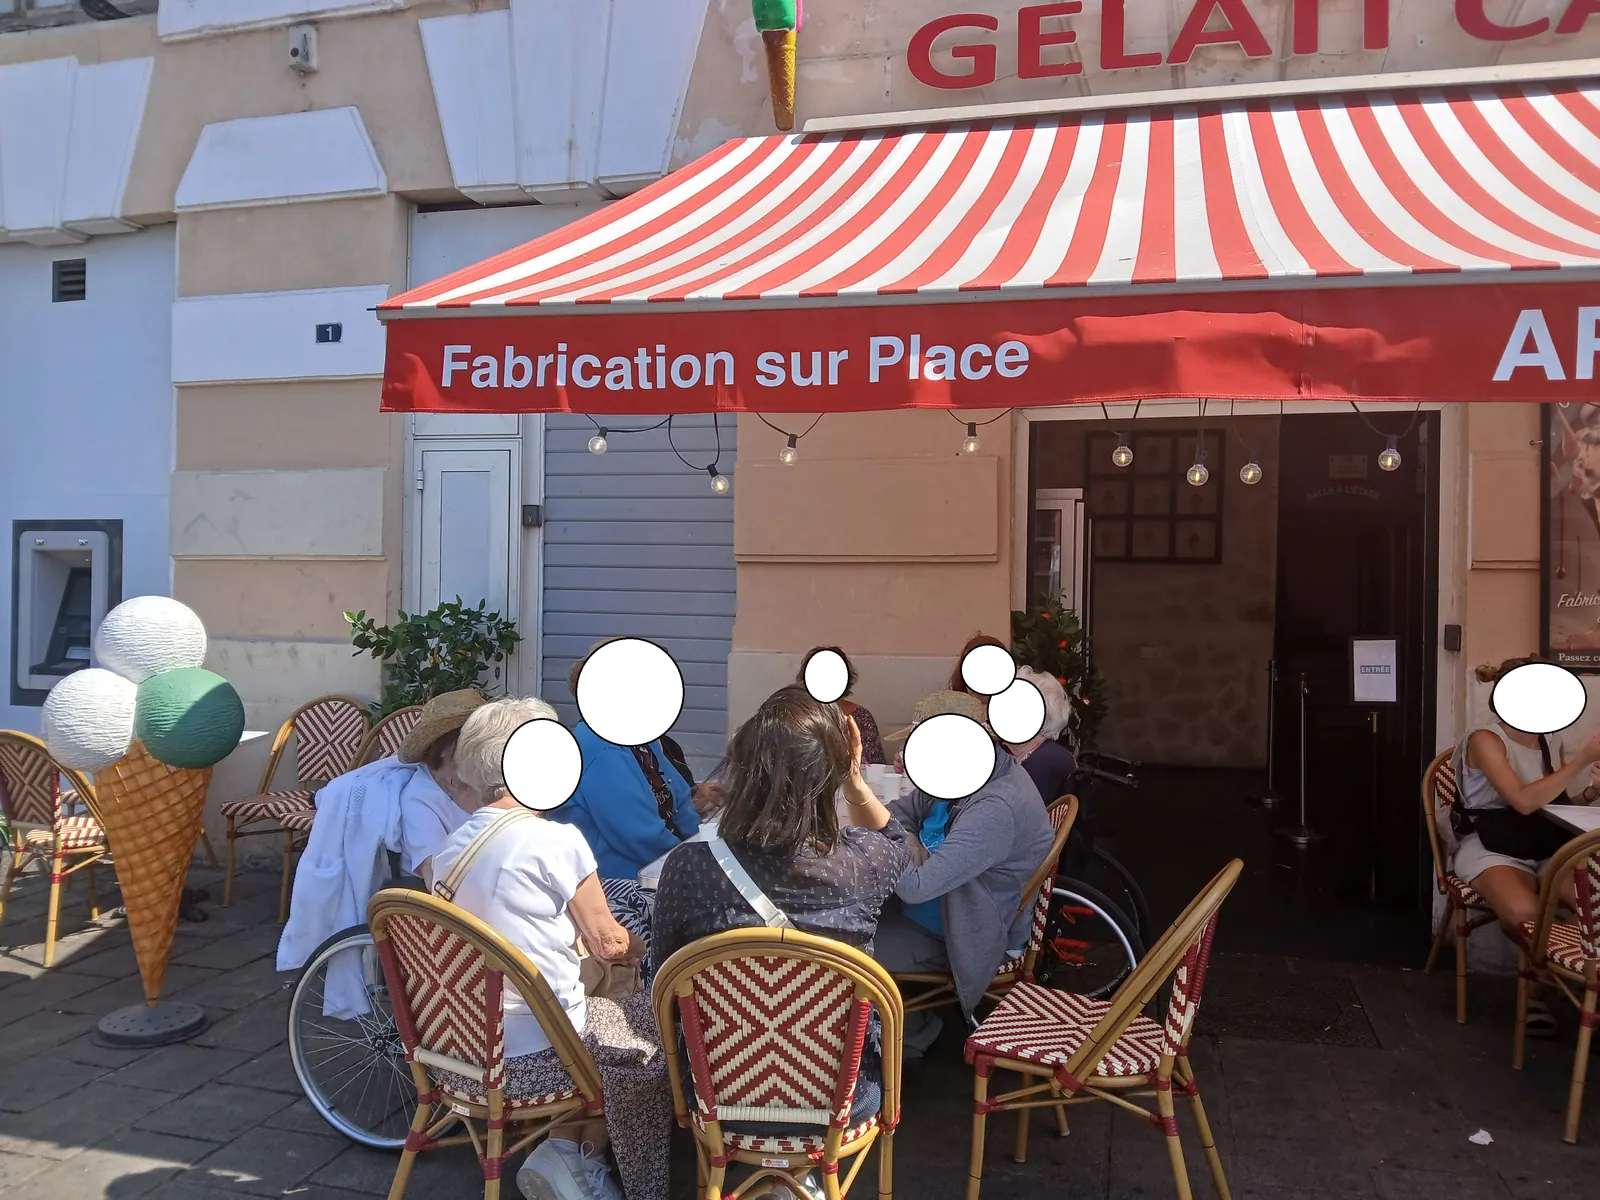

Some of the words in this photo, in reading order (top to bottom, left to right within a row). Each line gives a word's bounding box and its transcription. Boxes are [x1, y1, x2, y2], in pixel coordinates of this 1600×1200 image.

[326, 325, 333, 341] 1
[440, 341, 736, 391] Fabrication
[754, 349, 850, 388] sur
[868, 333, 1031, 384] Place
[1558, 652, 1591, 662] Passez
